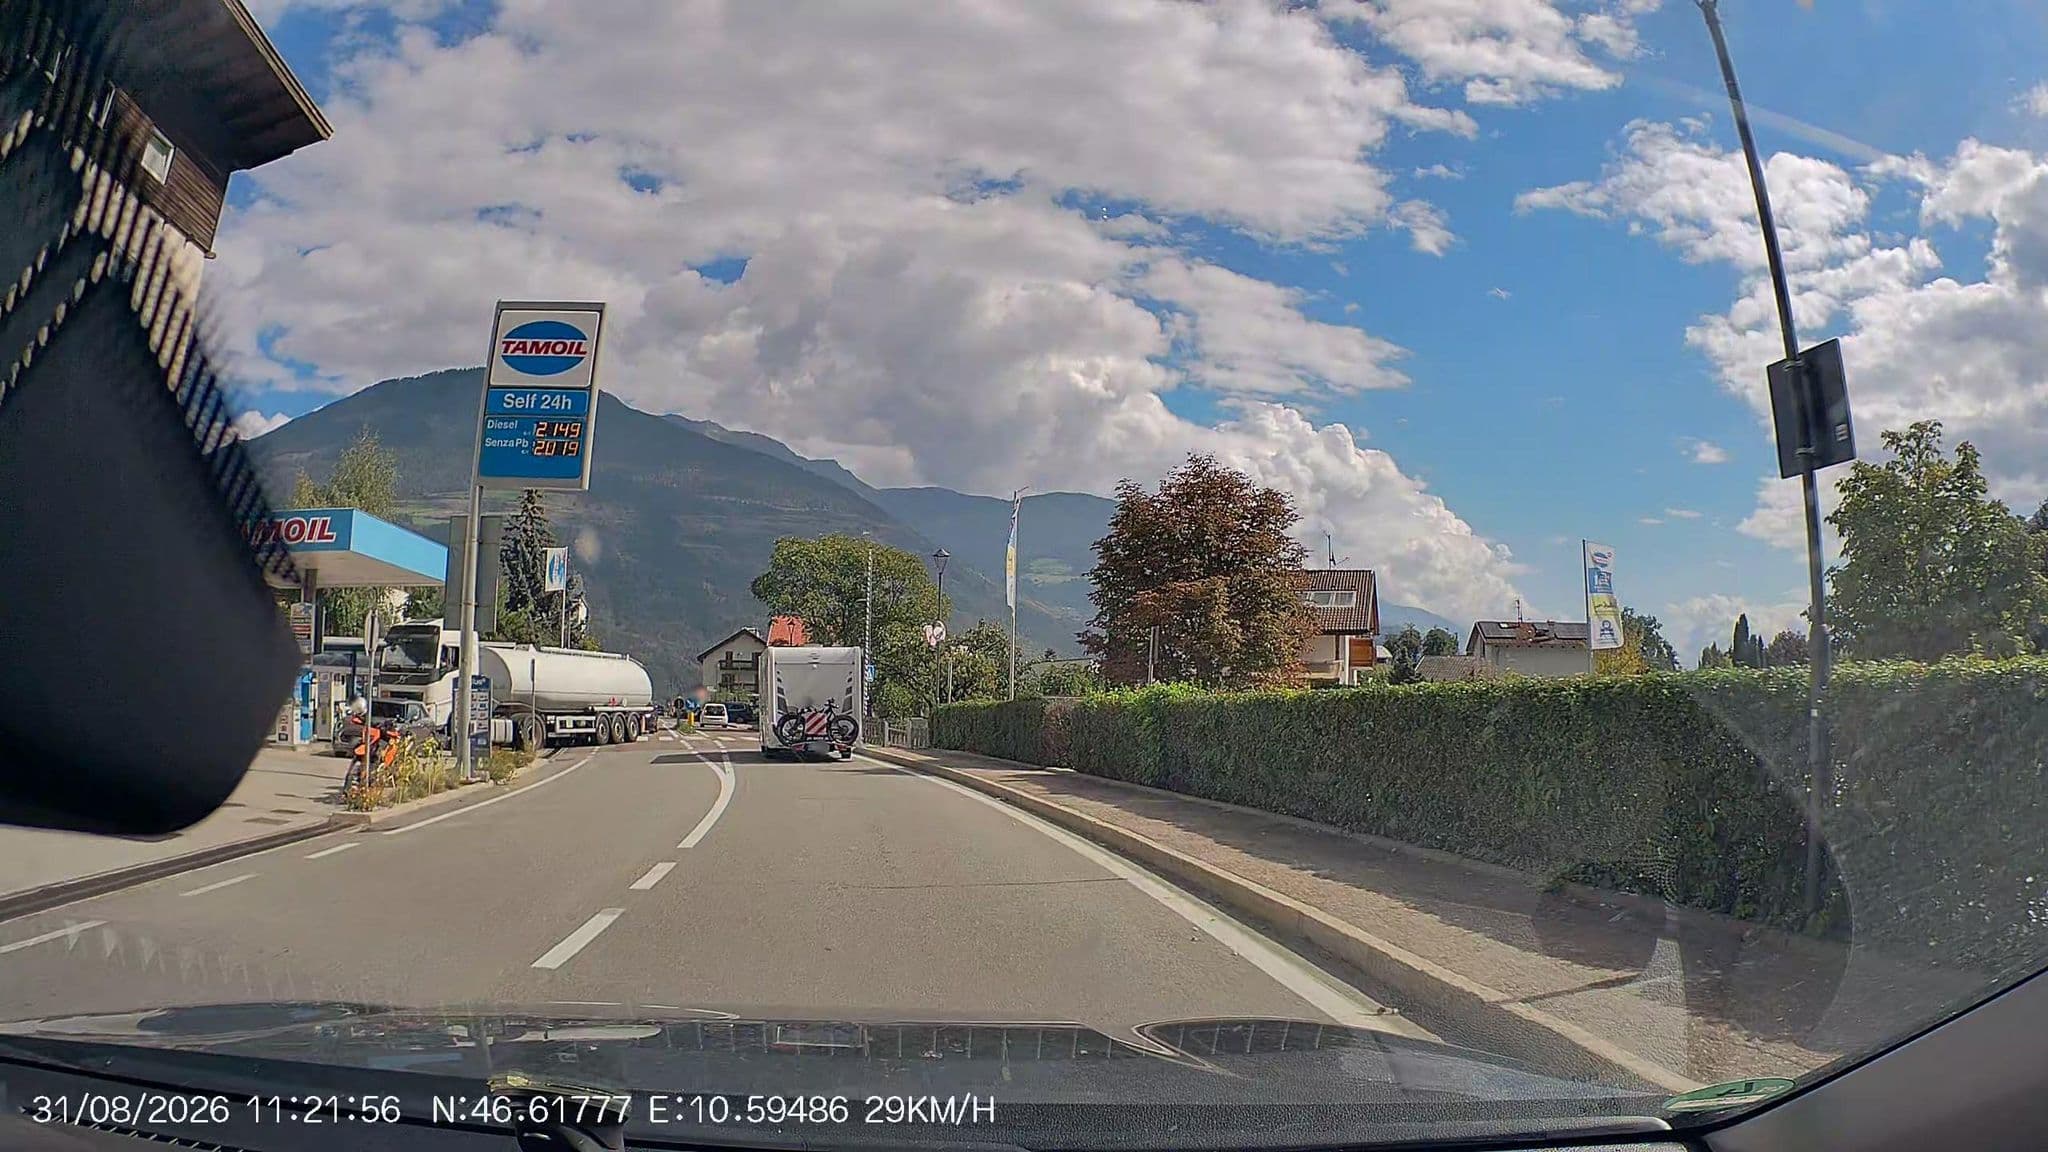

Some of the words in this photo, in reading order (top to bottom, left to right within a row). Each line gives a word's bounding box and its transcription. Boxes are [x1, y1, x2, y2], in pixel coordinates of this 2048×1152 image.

[501, 340, 588, 356] TAMOIL
[503, 393, 537, 409] Self
[540, 395, 572, 410] 24h
[487, 419, 518, 429] Diesel
[484, 437, 514, 448] Senza
[515, 438, 529, 448] Pb
